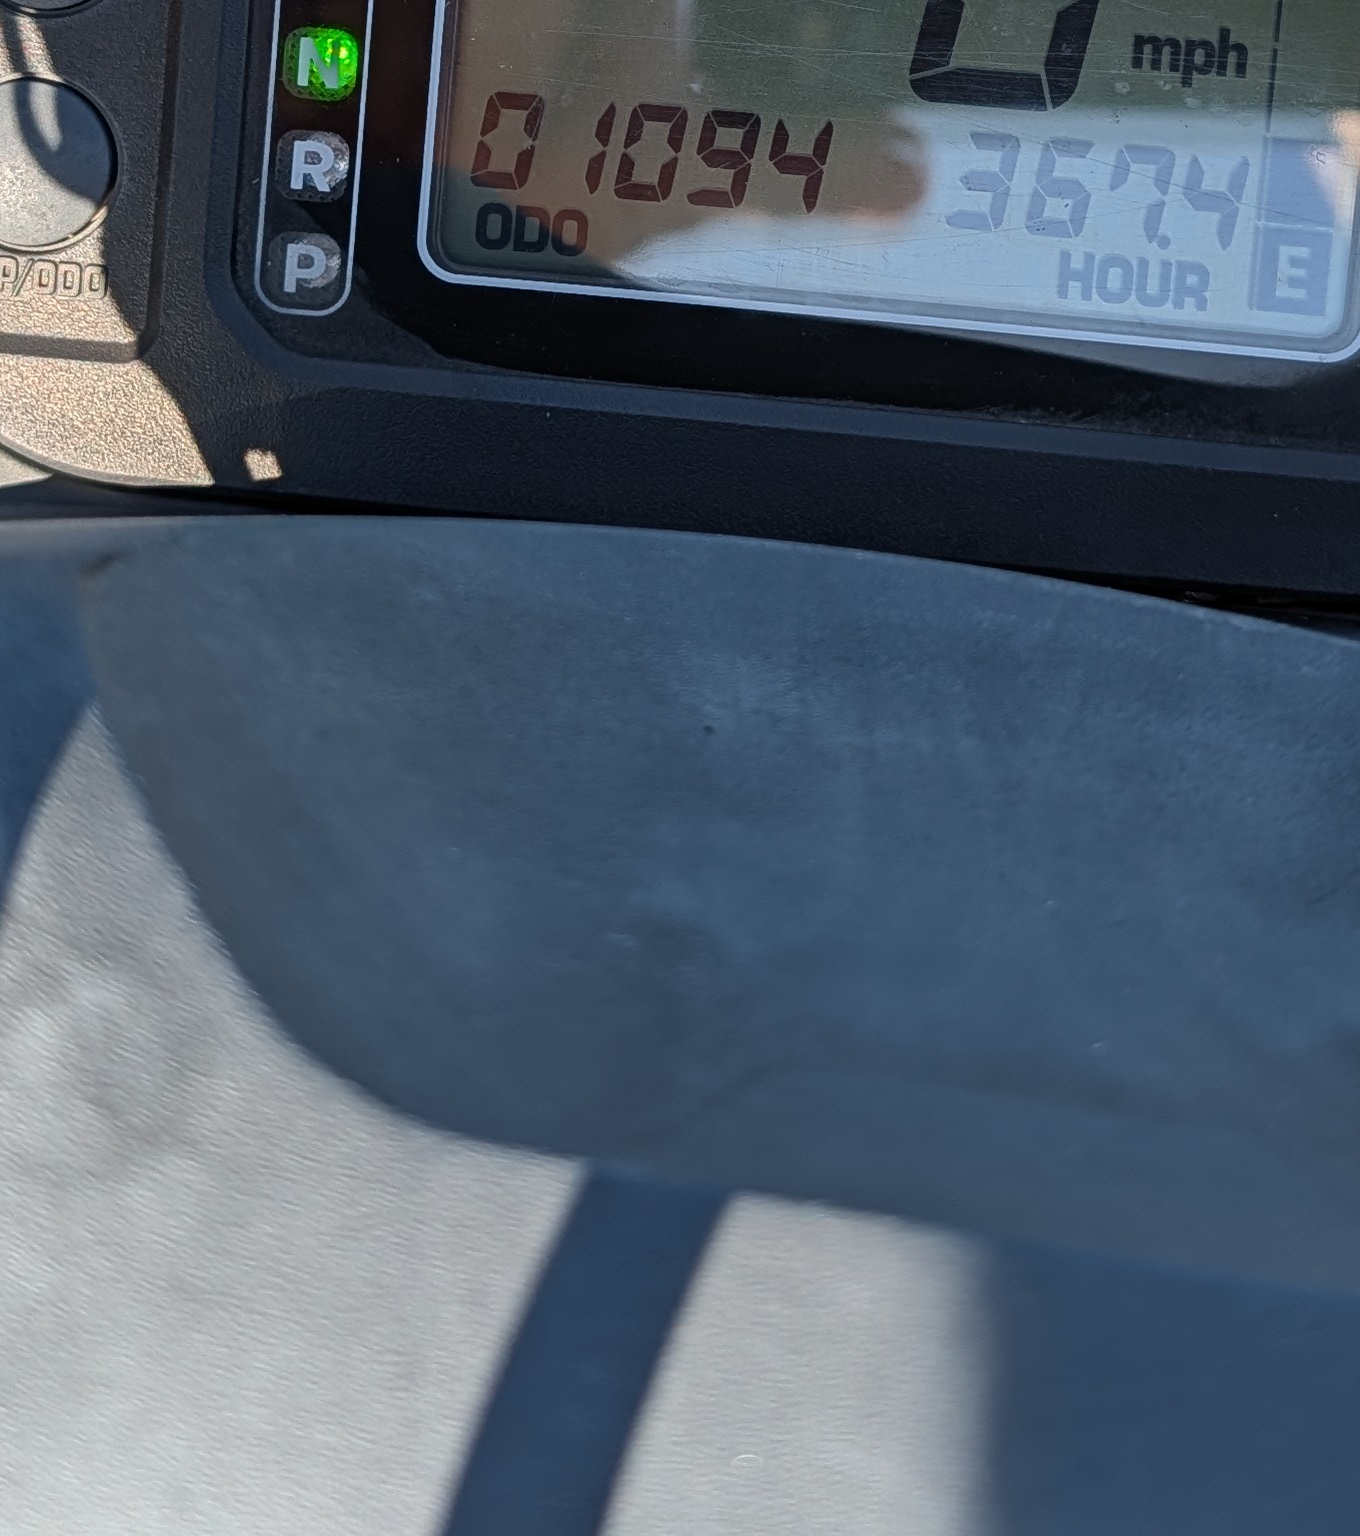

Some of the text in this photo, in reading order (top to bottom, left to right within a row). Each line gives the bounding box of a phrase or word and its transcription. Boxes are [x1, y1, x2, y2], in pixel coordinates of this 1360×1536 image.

[297, 38, 339, 89] N
[1132, 26, 1249, 88] mph
[290, 141, 328, 192] R
[470, 91, 834, 214] 01094
[475, 202, 588, 257] ODO
[283, 244, 328, 292] P
[1057, 249, 1210, 313] HOUR
[1274, 243, 1310, 299] E
